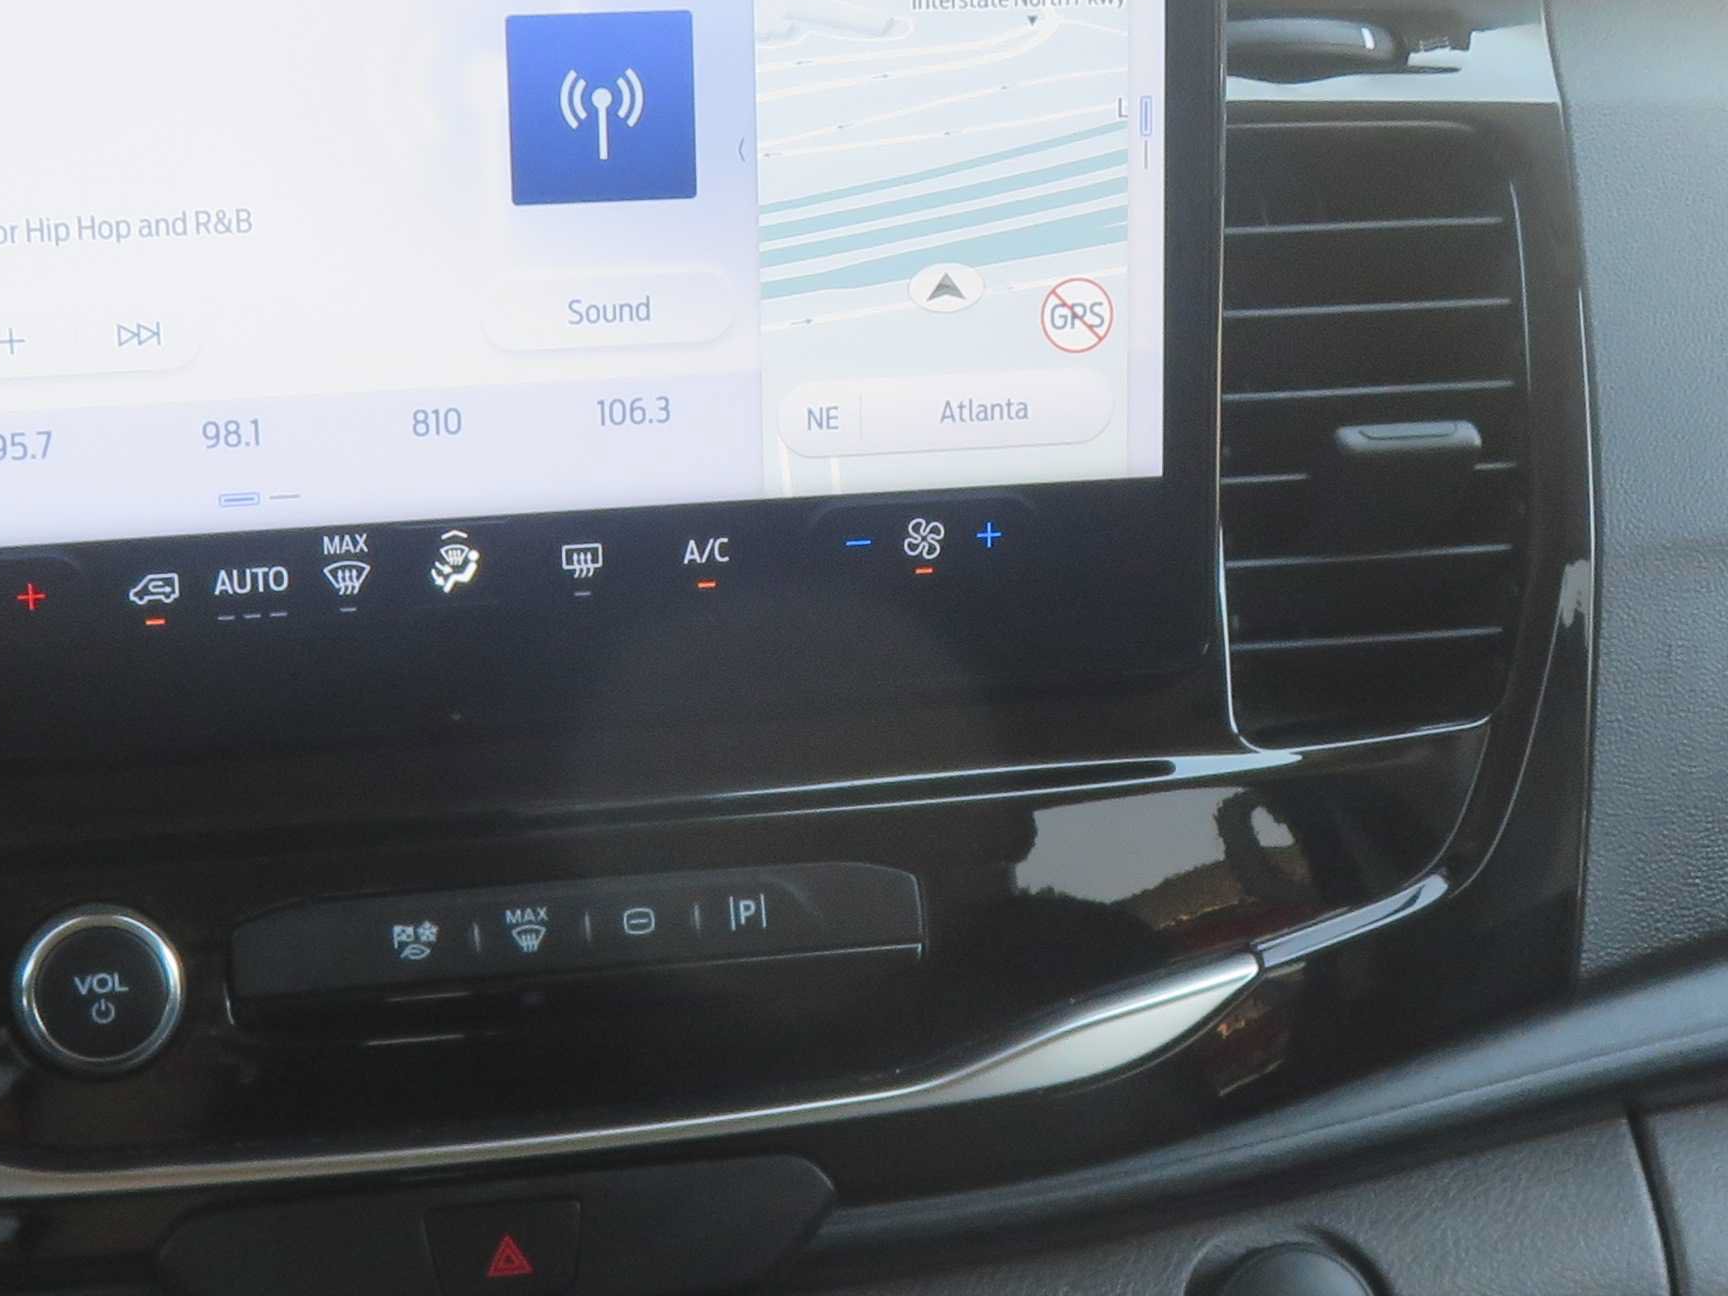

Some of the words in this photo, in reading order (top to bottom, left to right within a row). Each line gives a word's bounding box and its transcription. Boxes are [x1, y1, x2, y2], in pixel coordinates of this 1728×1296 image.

[24, 215, 72, 249] Hip
[77, 213, 134, 248] Hop
[138, 211, 189, 240] and
[195, 207, 255, 237] R&B
[566, 295, 653, 327] Sound
[1048, 301, 1106, 332] GPS
[201, 416, 262, 450] 98.1
[411, 405, 463, 439] 810
[595, 395, 672, 429] 106.3
[805, 403, 841, 433] NE
[938, 394, 1030, 427] Atlanta
[322, 532, 370, 555] MAX
[682, 535, 731, 565] A/C
[214, 565, 291, 596] AUTO
[504, 905, 550, 925] MAX
[74, 972, 130, 997] VOL
